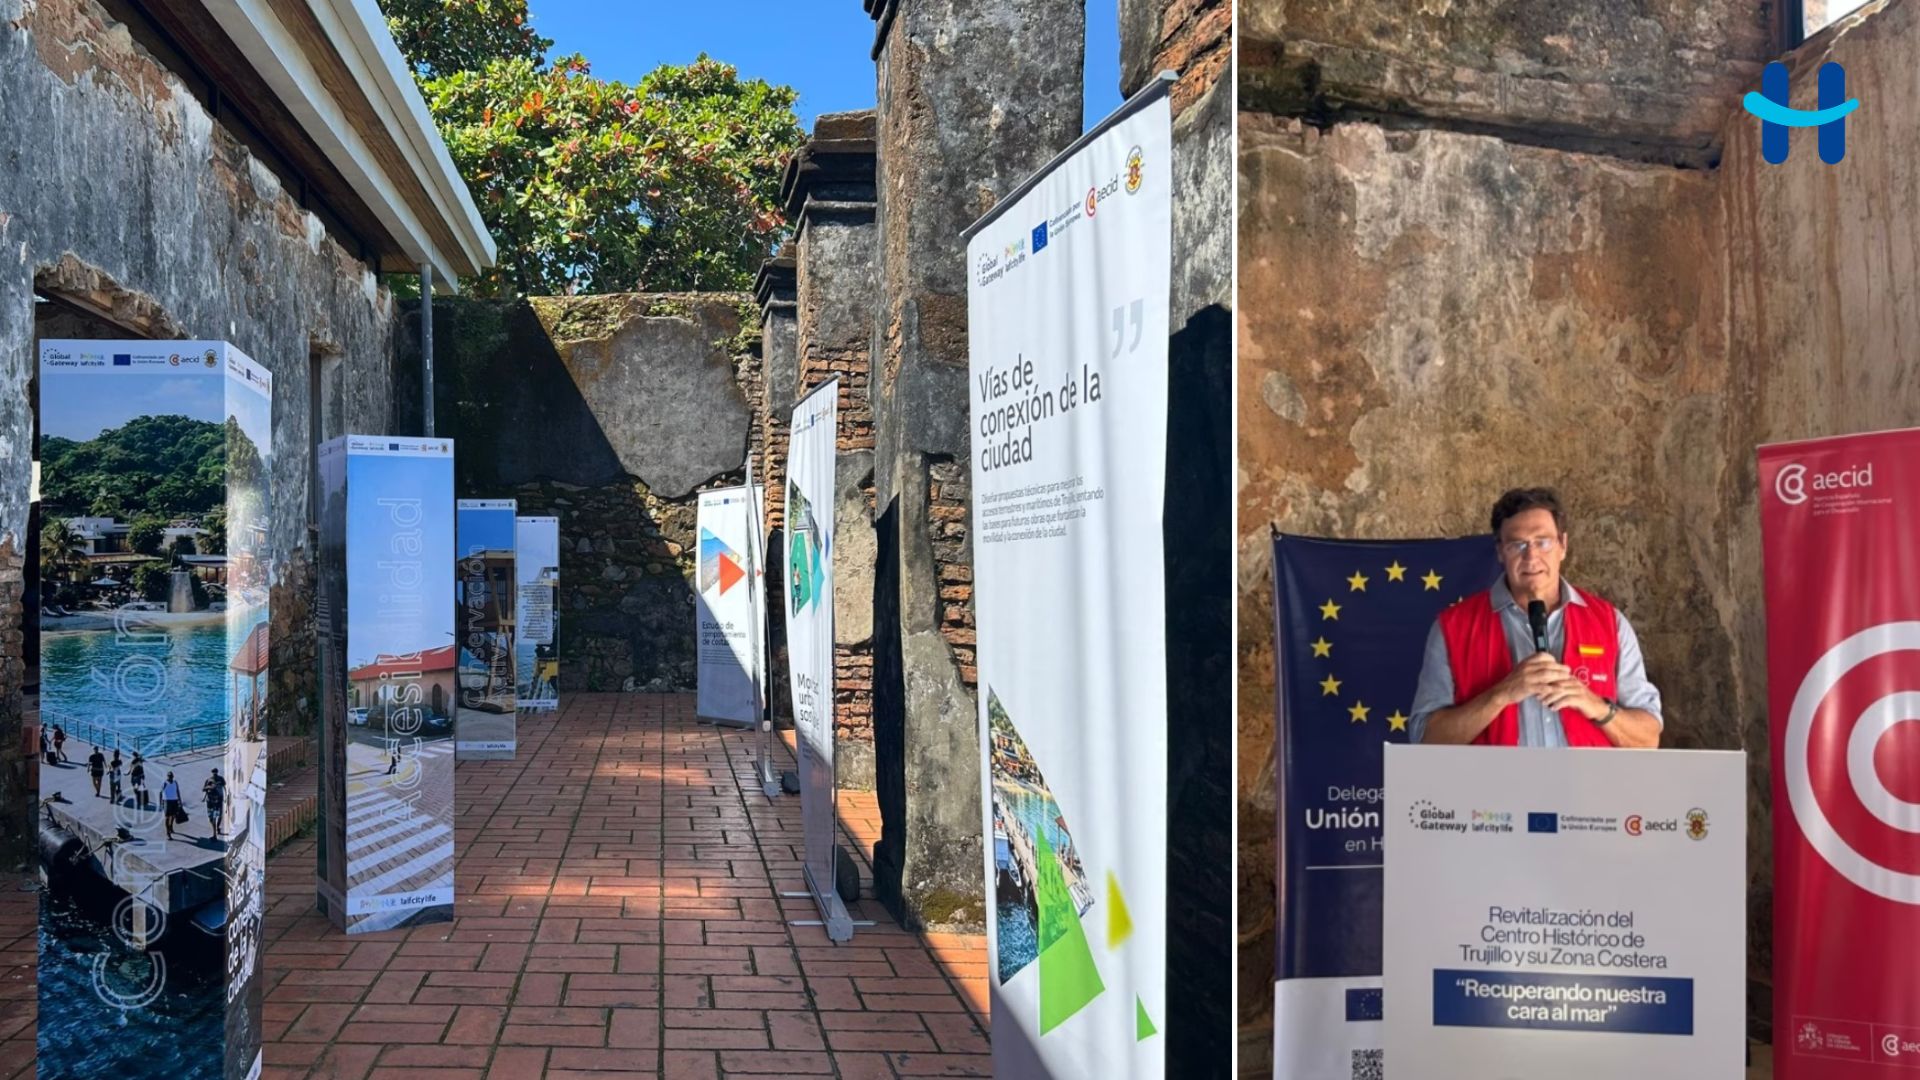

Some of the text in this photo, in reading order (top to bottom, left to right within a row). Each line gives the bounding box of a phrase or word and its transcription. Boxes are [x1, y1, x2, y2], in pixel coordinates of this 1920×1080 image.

[1096, 174, 1119, 205] aecid
[981, 254, 999, 275] Global
[49, 352, 71, 360] Global
[49, 360, 78, 368] Gateway
[979, 352, 1034, 404] Vías de
[980, 363, 1102, 438] conexión de la
[981, 425, 1033, 473] ciudad
[1813, 463, 1872, 490] aecid
[463, 542, 486, 709] Conservación
[377, 496, 423, 822] Accesibilidad
[91, 600, 168, 1009] Conexión
[1420, 808, 1455, 820] Global
[1305, 806, 1379, 829] Unión
[1420, 820, 1467, 833] Gateway
[1645, 819, 1677, 832] aecid
[1344, 839, 1366, 853] en
[1489, 905, 1634, 928] Revitalización del
[1480, 925, 1645, 948] Centro Histórico de
[1458, 944, 1668, 970] Trujillo y su Zona Costera
[1455, 979, 1667, 1005] “Recuperando nuestra
[1507, 1004, 1618, 1024] cara al mar”
